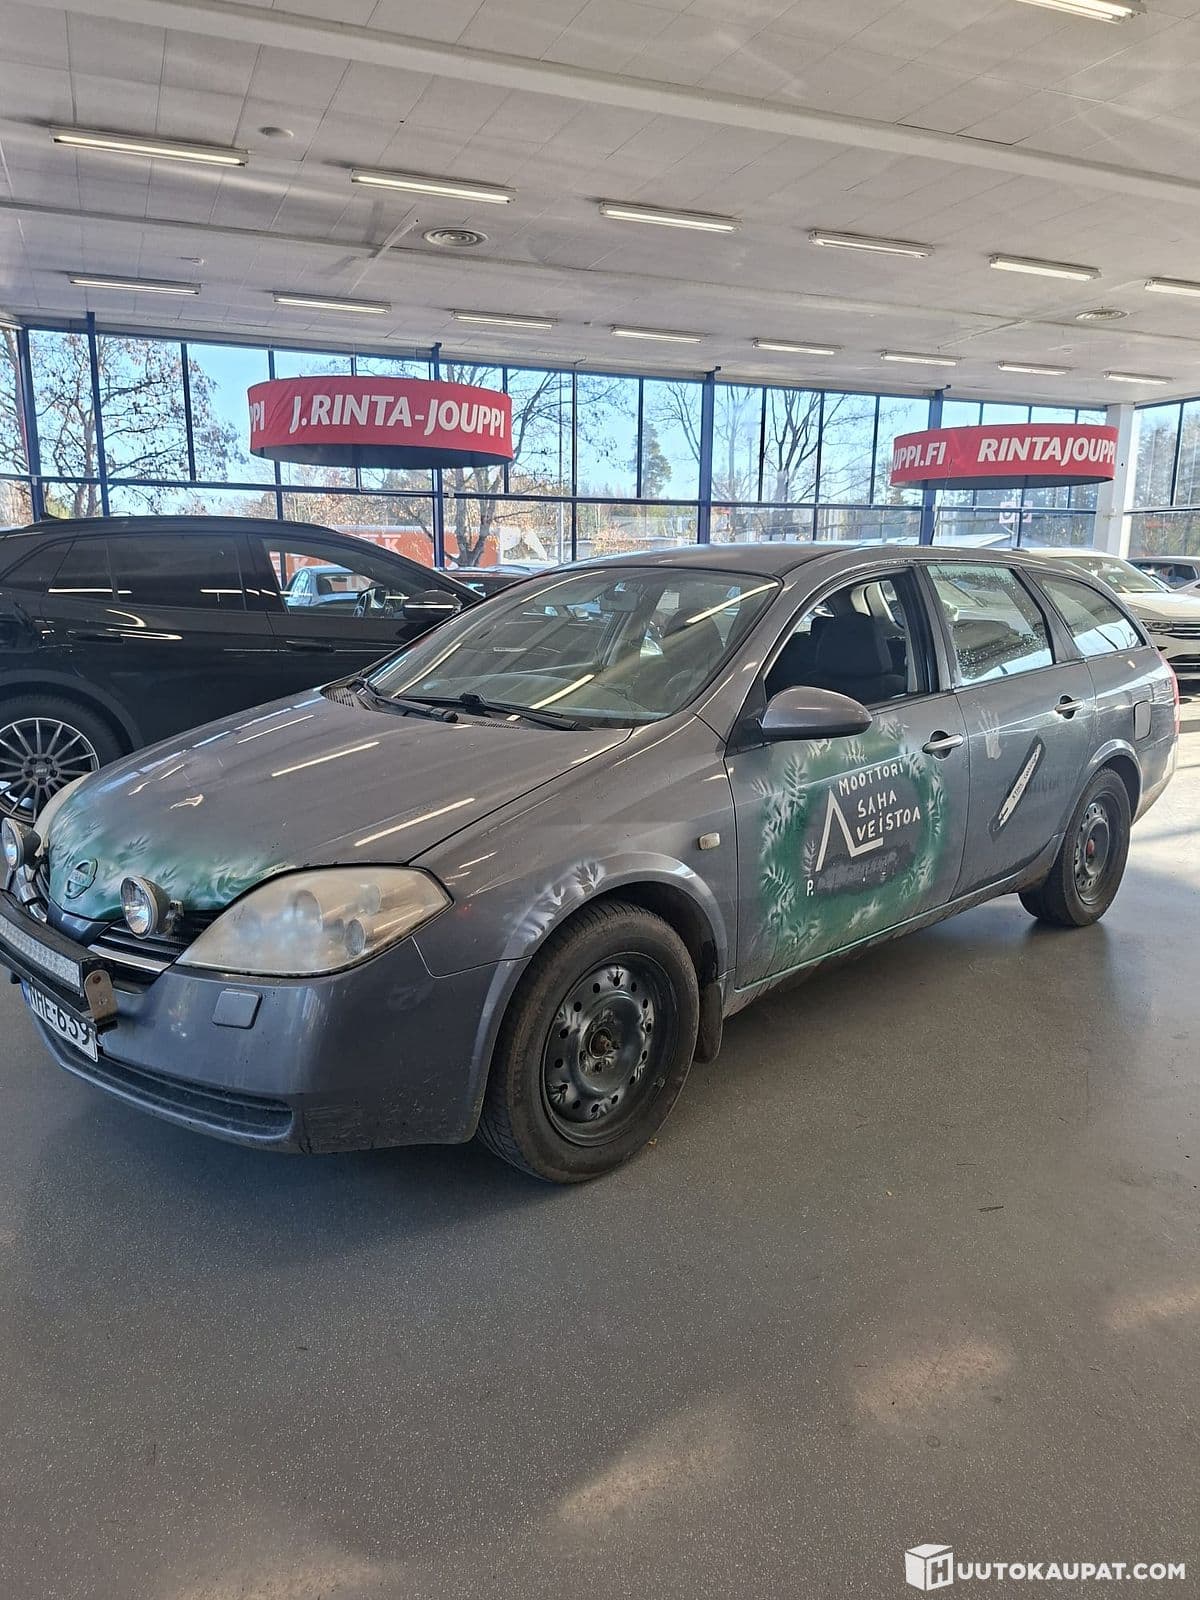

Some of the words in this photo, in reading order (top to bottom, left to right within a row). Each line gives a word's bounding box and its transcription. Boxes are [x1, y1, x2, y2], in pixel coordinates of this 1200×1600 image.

[289, 394, 505, 438] J.RINTA-JOUPPI
[838, 762, 904, 797] MOOTTORI
[857, 790, 897, 818] SAHA
